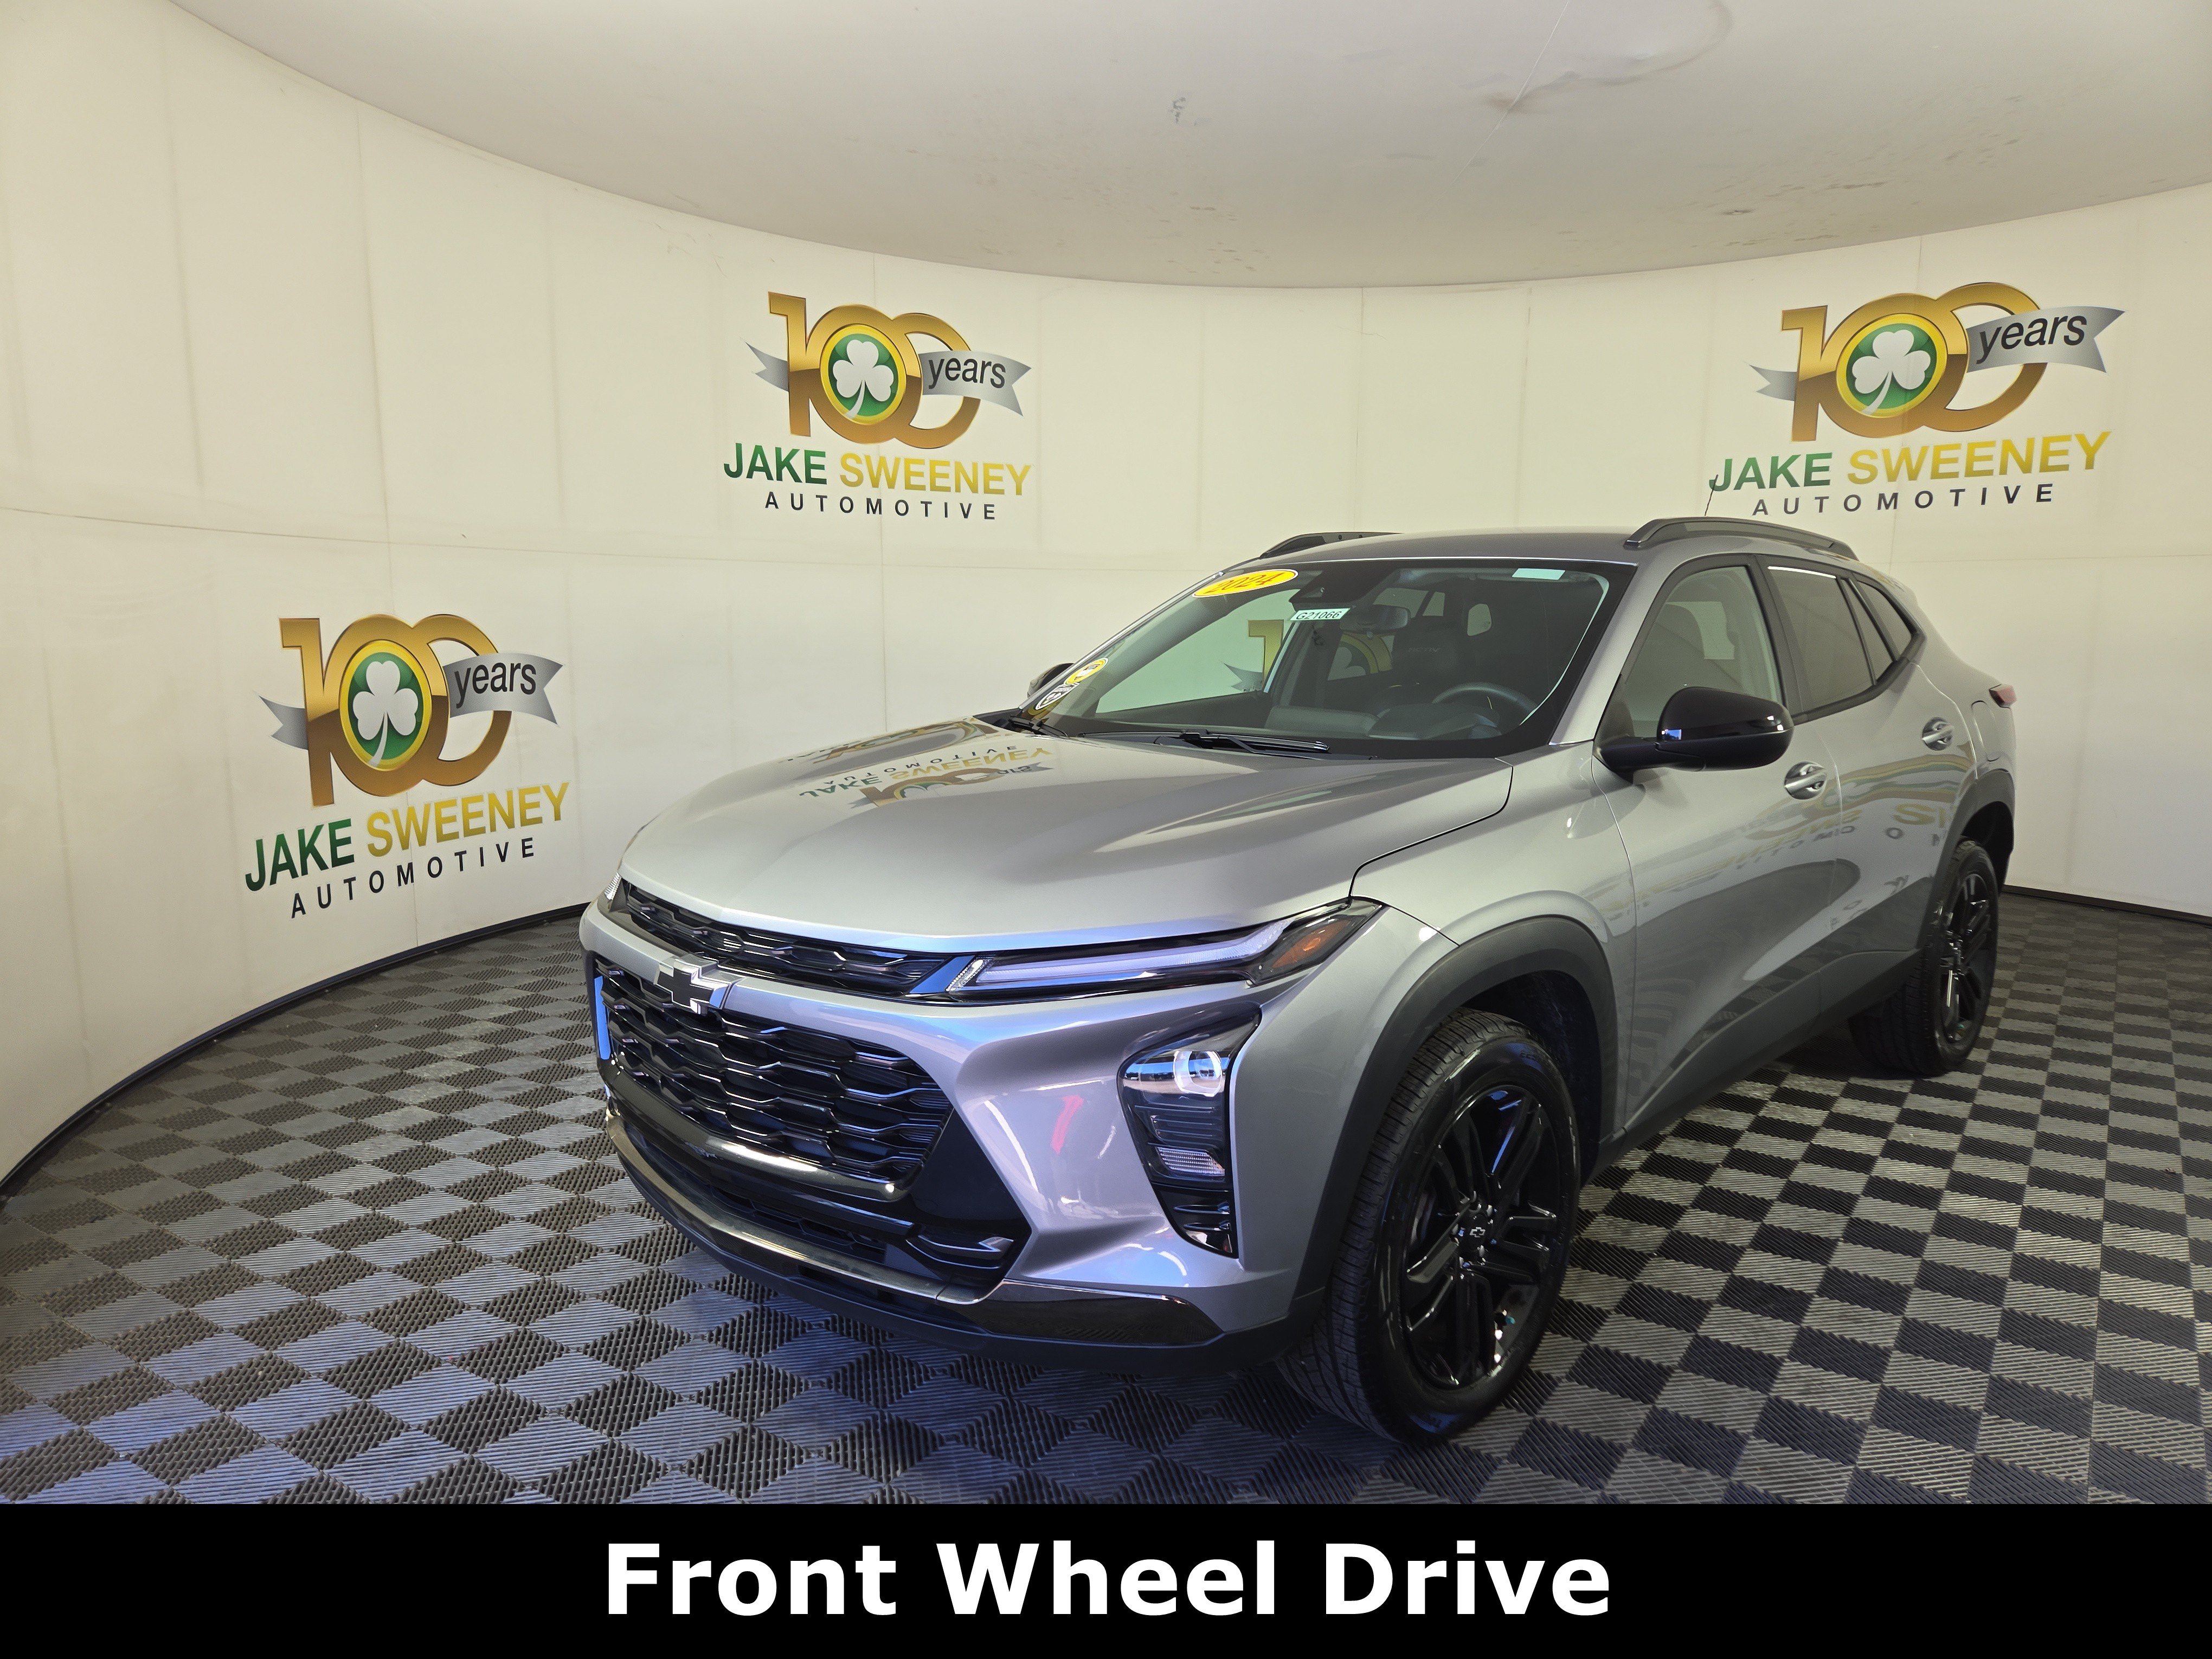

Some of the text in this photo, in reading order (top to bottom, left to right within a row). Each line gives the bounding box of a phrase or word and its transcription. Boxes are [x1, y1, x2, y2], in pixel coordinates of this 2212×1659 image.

[768, 291, 1006, 449] 100 years
[1782, 282, 2087, 442] 100 years
[723, 442, 1031, 496] JAKE SWEENEY
[1709, 431, 2111, 492] JAKE SWEENEY
[765, 492, 995, 520] AUTOMOTIVE
[1752, 483, 2053, 516] AUTOMOTIVE
[1203, 573, 1285, 594] 2024
[1296, 611, 1342, 620] G21066
[279, 614, 536, 806] 100 years
[245, 782, 570, 892] JAKE SWEENEY
[291, 837, 535, 918] AUTOMOTIVE
